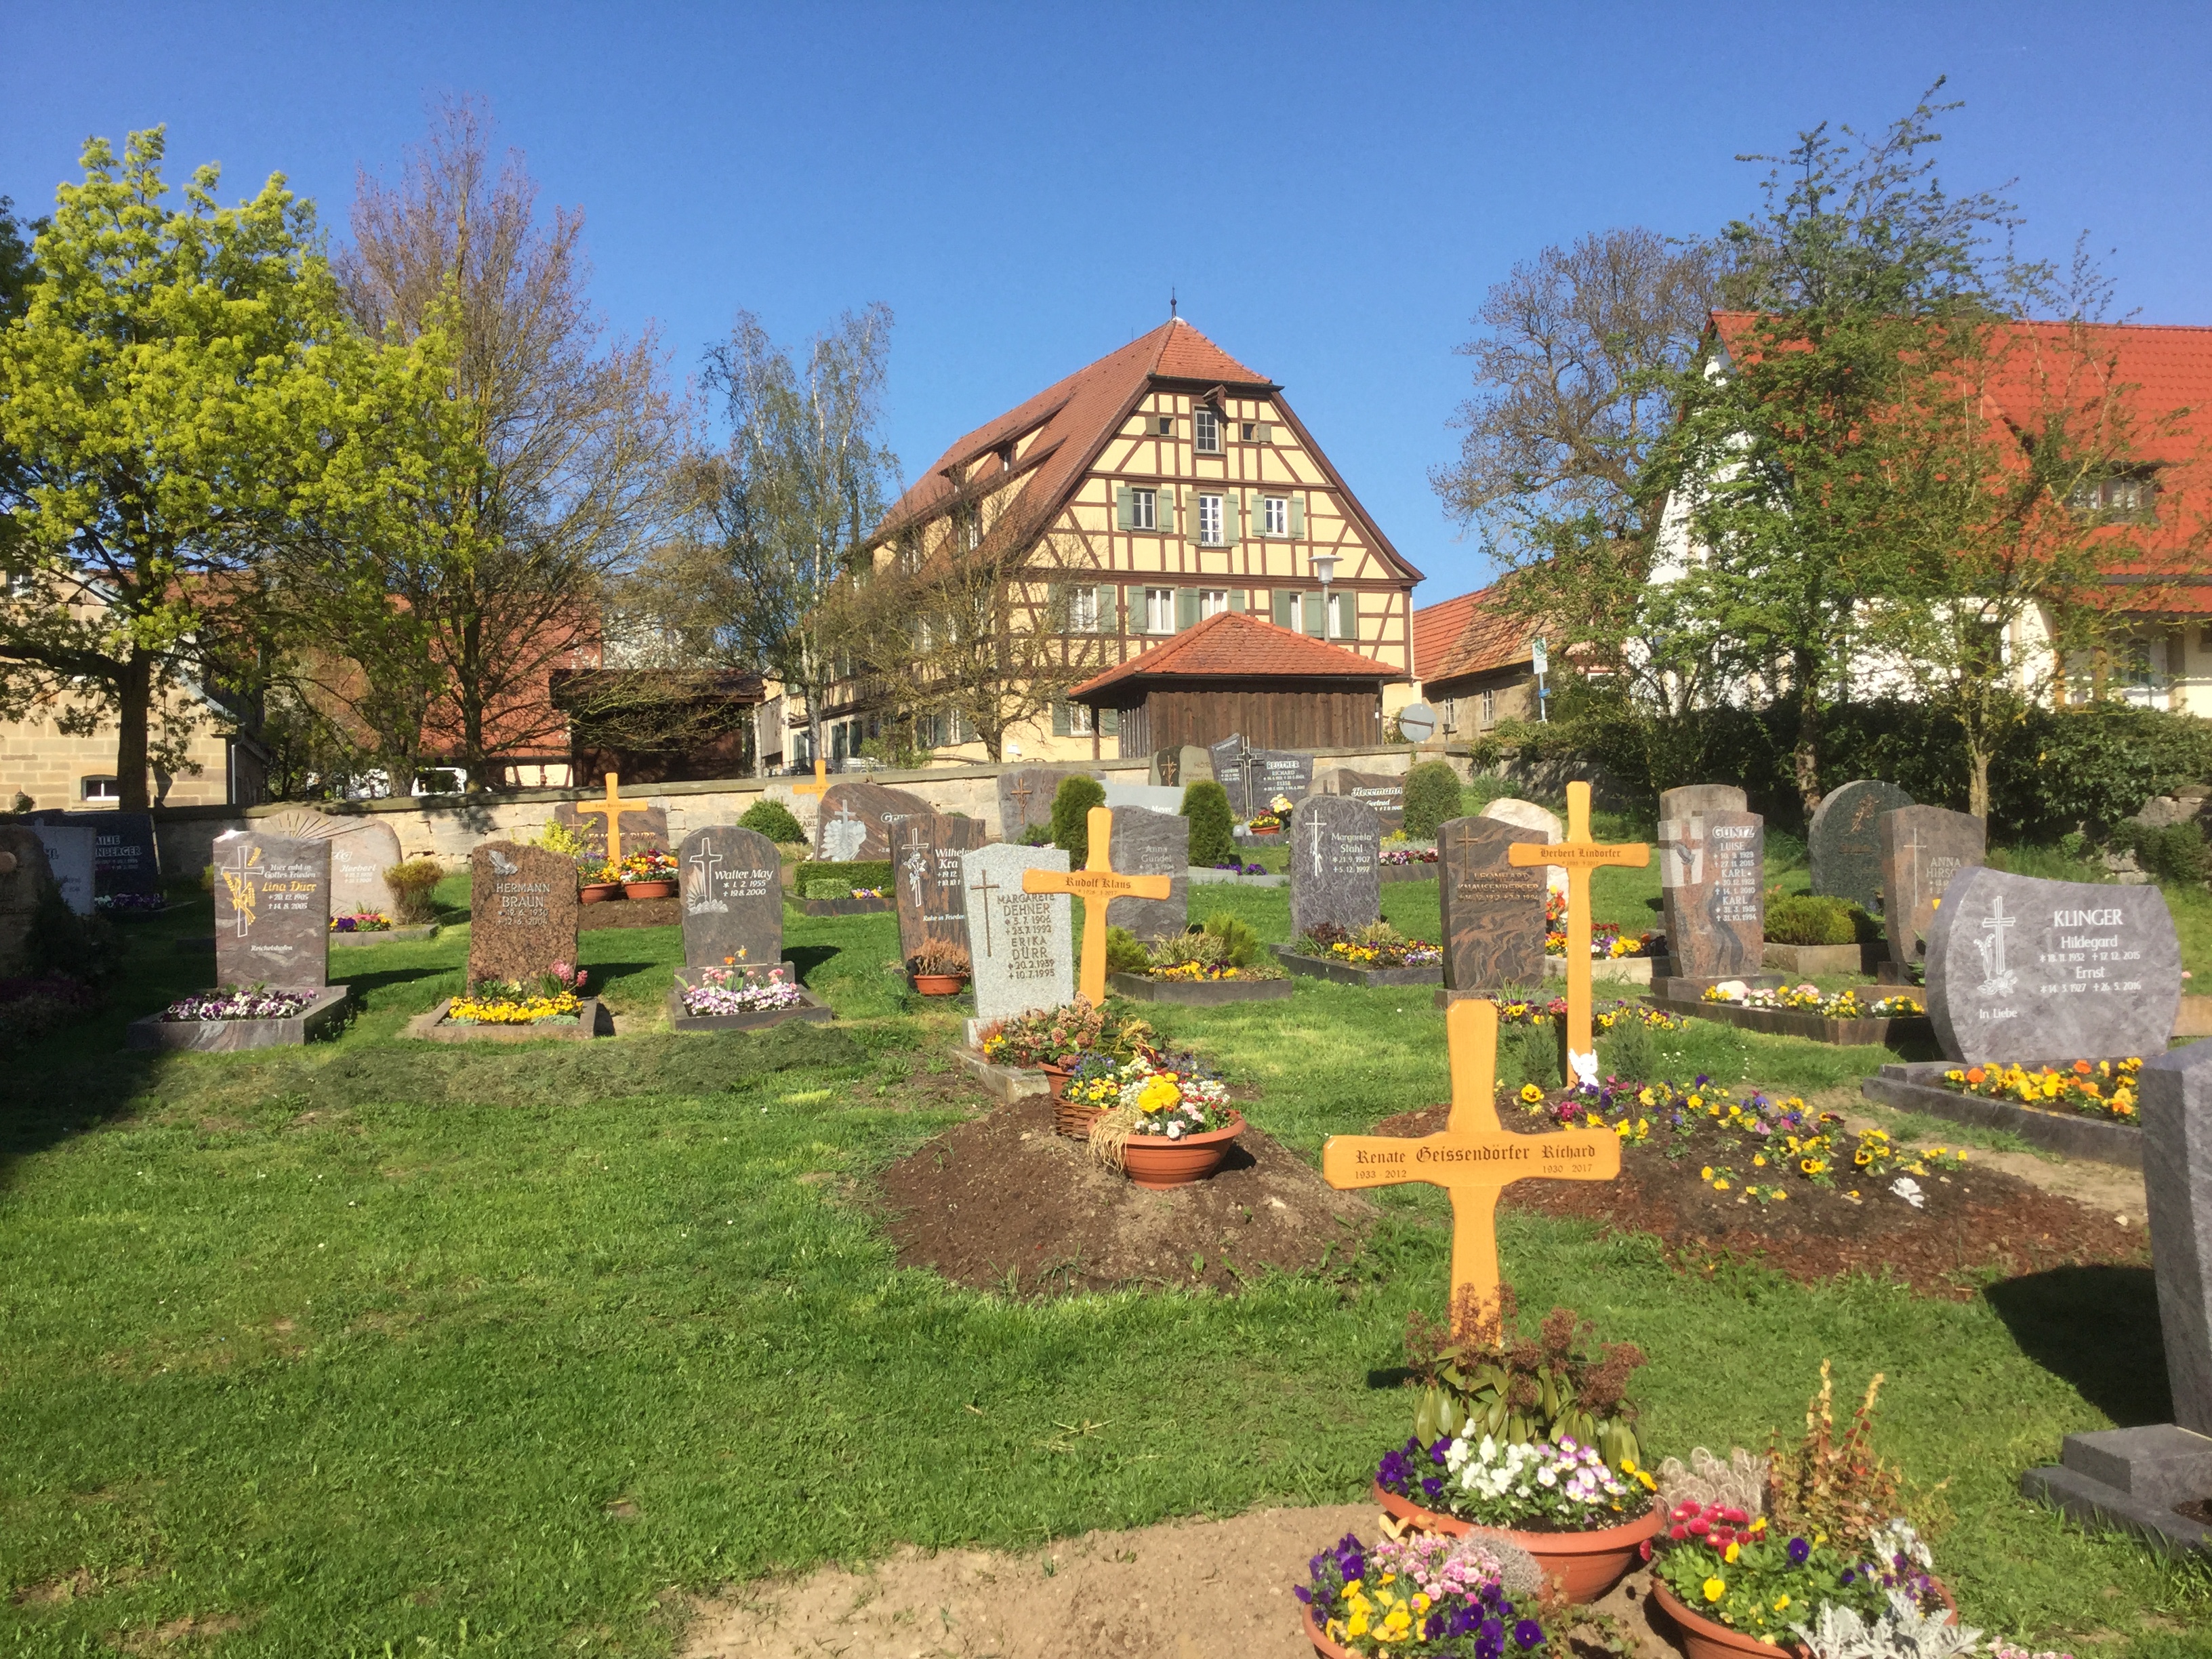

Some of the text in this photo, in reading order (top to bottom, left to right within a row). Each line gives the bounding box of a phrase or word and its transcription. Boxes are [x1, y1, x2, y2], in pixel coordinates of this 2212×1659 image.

[1267, 760, 1299, 769] REUTHER
[1351, 787, 1403, 797] Herrmann
[1151, 805, 1172, 813] Meyer
[588, 832, 626, 840] FAME
[96, 846, 142, 857] NBERGER
[1340, 844, 1363, 853] Stahl
[1721, 842, 1745, 851] LUISE
[1540, 848, 1575, 859] Herbert
[939, 859, 958, 869] Kra
[1740, 859, 1755, 867] 2015
[1930, 857, 1961, 867] ANNA
[340, 864, 376, 873] Herbert
[1721, 868, 1746, 878] KARL
[1926, 867, 1957, 878] HIRSC
[715, 869, 774, 880] Walter May
[1474, 872, 1530, 882] LEONHARD
[262, 881, 287, 892] Lina
[496, 882, 550, 893] HERMANN
[750, 880, 766, 888] 1955
[1065, 877, 1131, 888] Rudolf Klaus
[502, 896, 544, 907] BRAUN
[997, 893, 1055, 904] MARGARETE
[1723, 895, 1748, 905] KARL
[529, 908, 549, 916] 1930
[1003, 903, 1050, 916] DEHNER
[1031, 915, 1051, 924] 1906
[2054, 909, 2123, 927] KLINGER
[1011, 936, 1047, 947] ERIKA
[2061, 935, 2118, 951] Hildegard
[1012, 946, 1048, 960] DÜRR
[2069, 953, 2085, 962] 1932
[2123, 951, 2140, 960] 2015
[2076, 966, 2105, 979] Ernst
[2070, 983, 2087, 992] 1927
[2123, 981, 2142, 991] 2016
[1980, 1007, 2018, 1019] In Liebe
[1355, 1145, 1595, 1164] Renate Geissendörfer Richard
[1543, 1164, 1593, 1173] 1930 2017
[1355, 1170, 1407, 1179] 1933 2012
